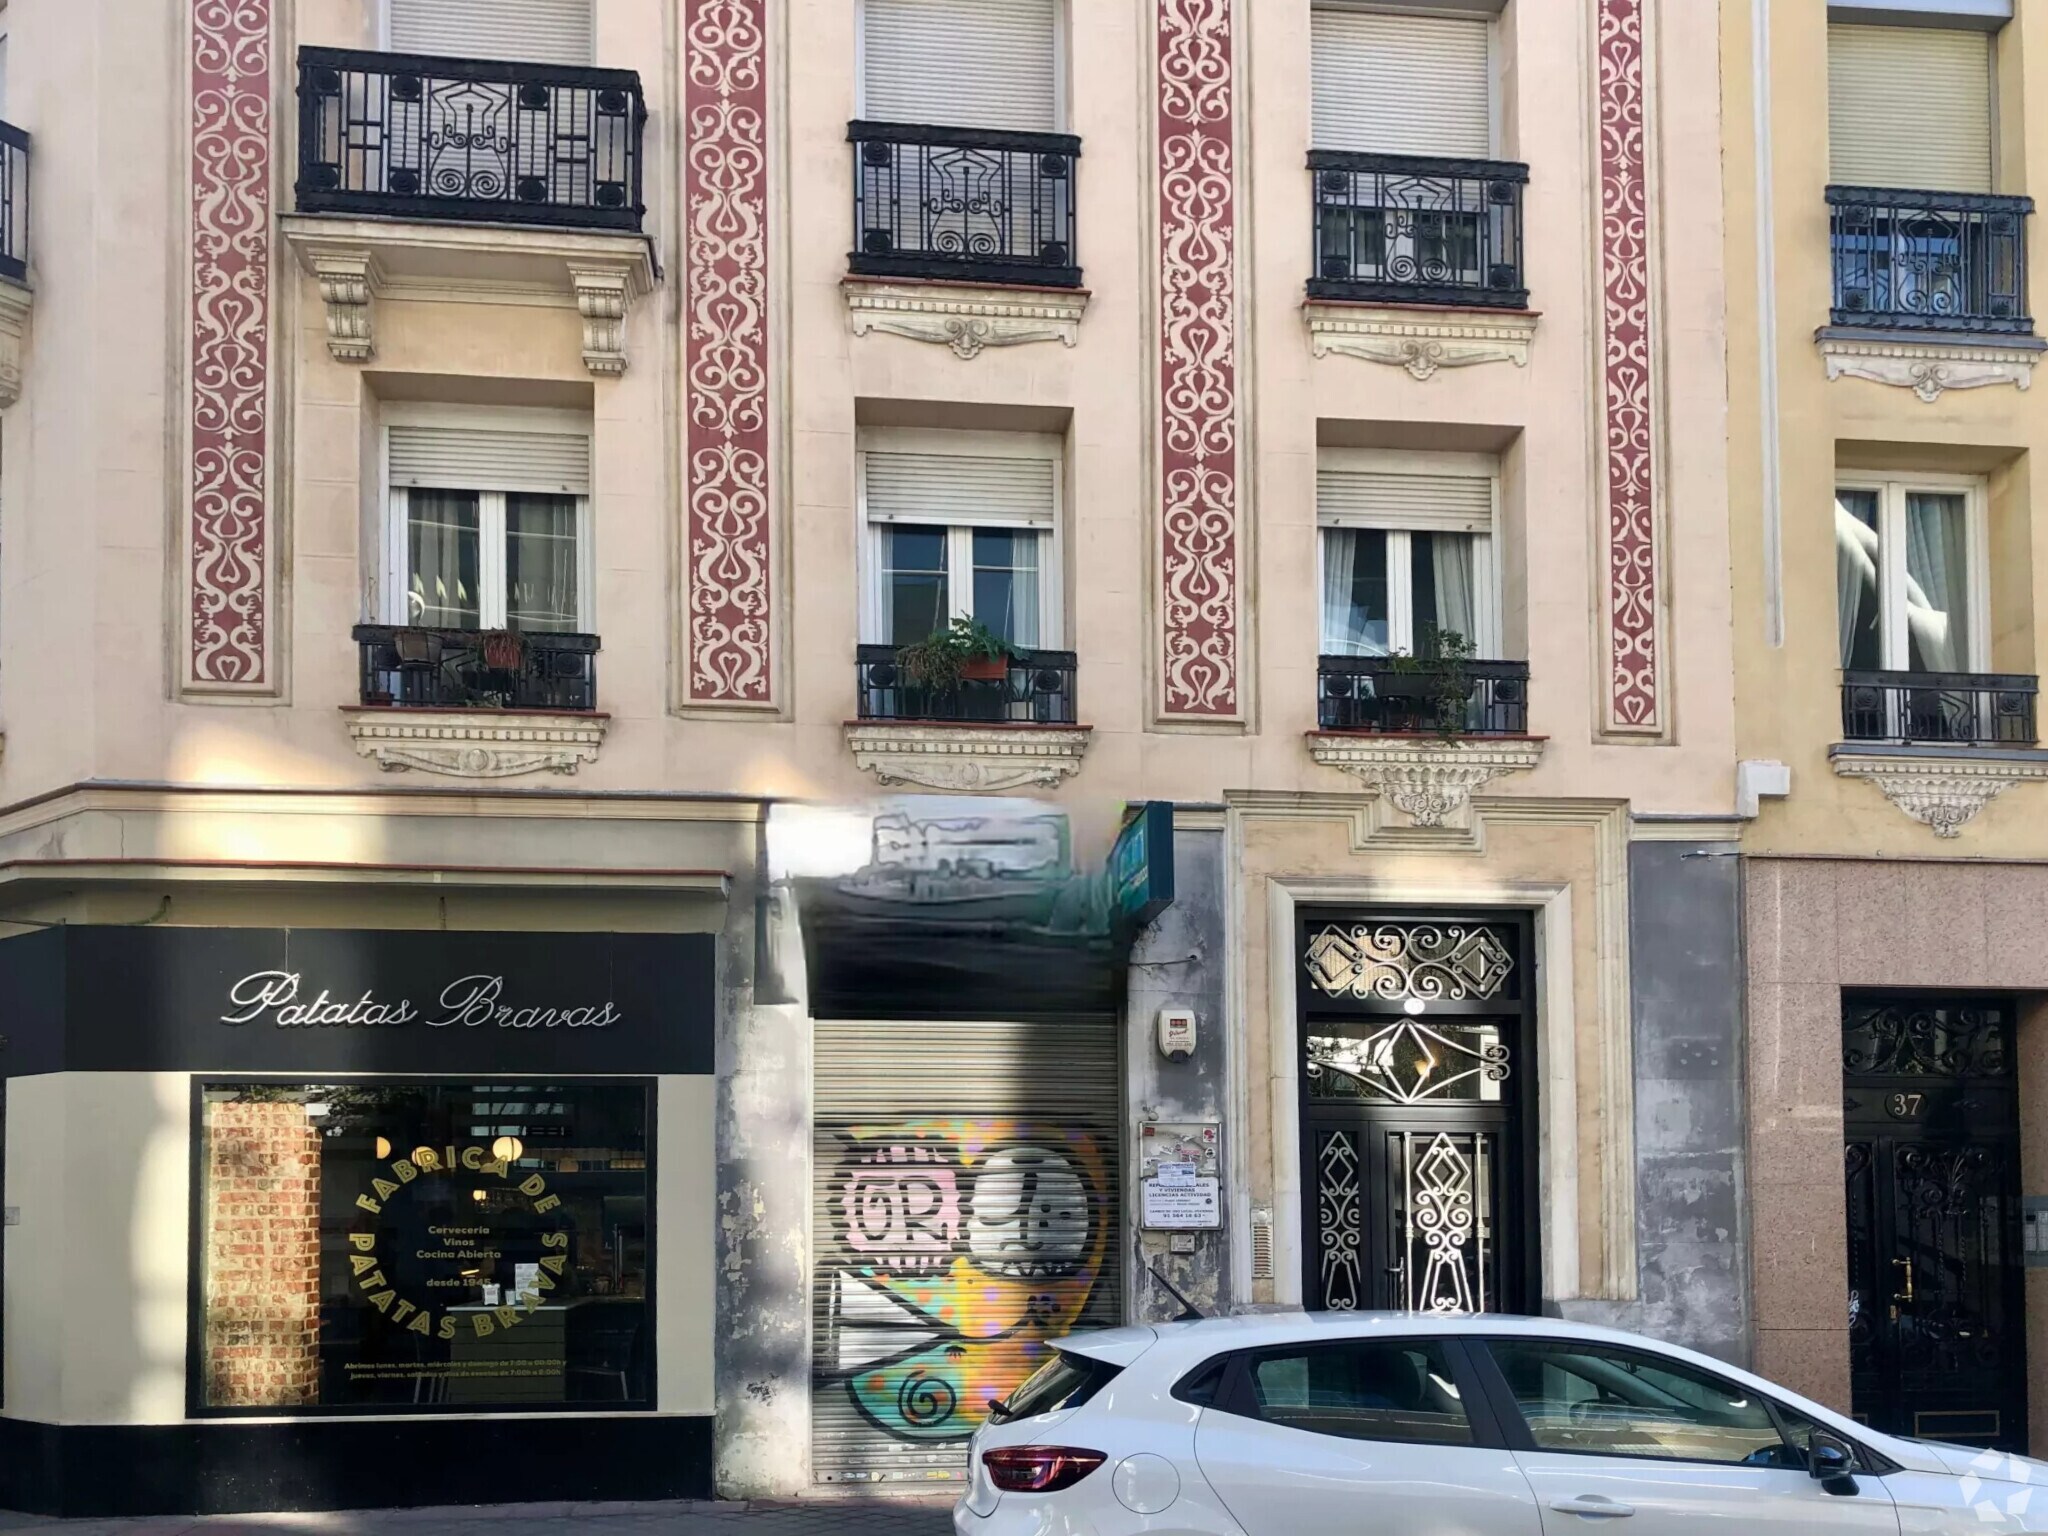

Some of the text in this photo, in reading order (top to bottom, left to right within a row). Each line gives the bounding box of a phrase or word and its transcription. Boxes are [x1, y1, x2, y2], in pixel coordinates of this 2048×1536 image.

[221, 970, 621, 1028] Patatas Bravas
[1894, 1093, 1922, 1116] 37
[356, 1145, 561, 1214] FABRICA DE
[443, 1238, 475, 1246] Vinos
[416, 1250, 501, 1259] Cocina Abierta
[349, 1232, 569, 1340] PATATAS BRAVAS
[426, 1278, 460, 1287] desde
